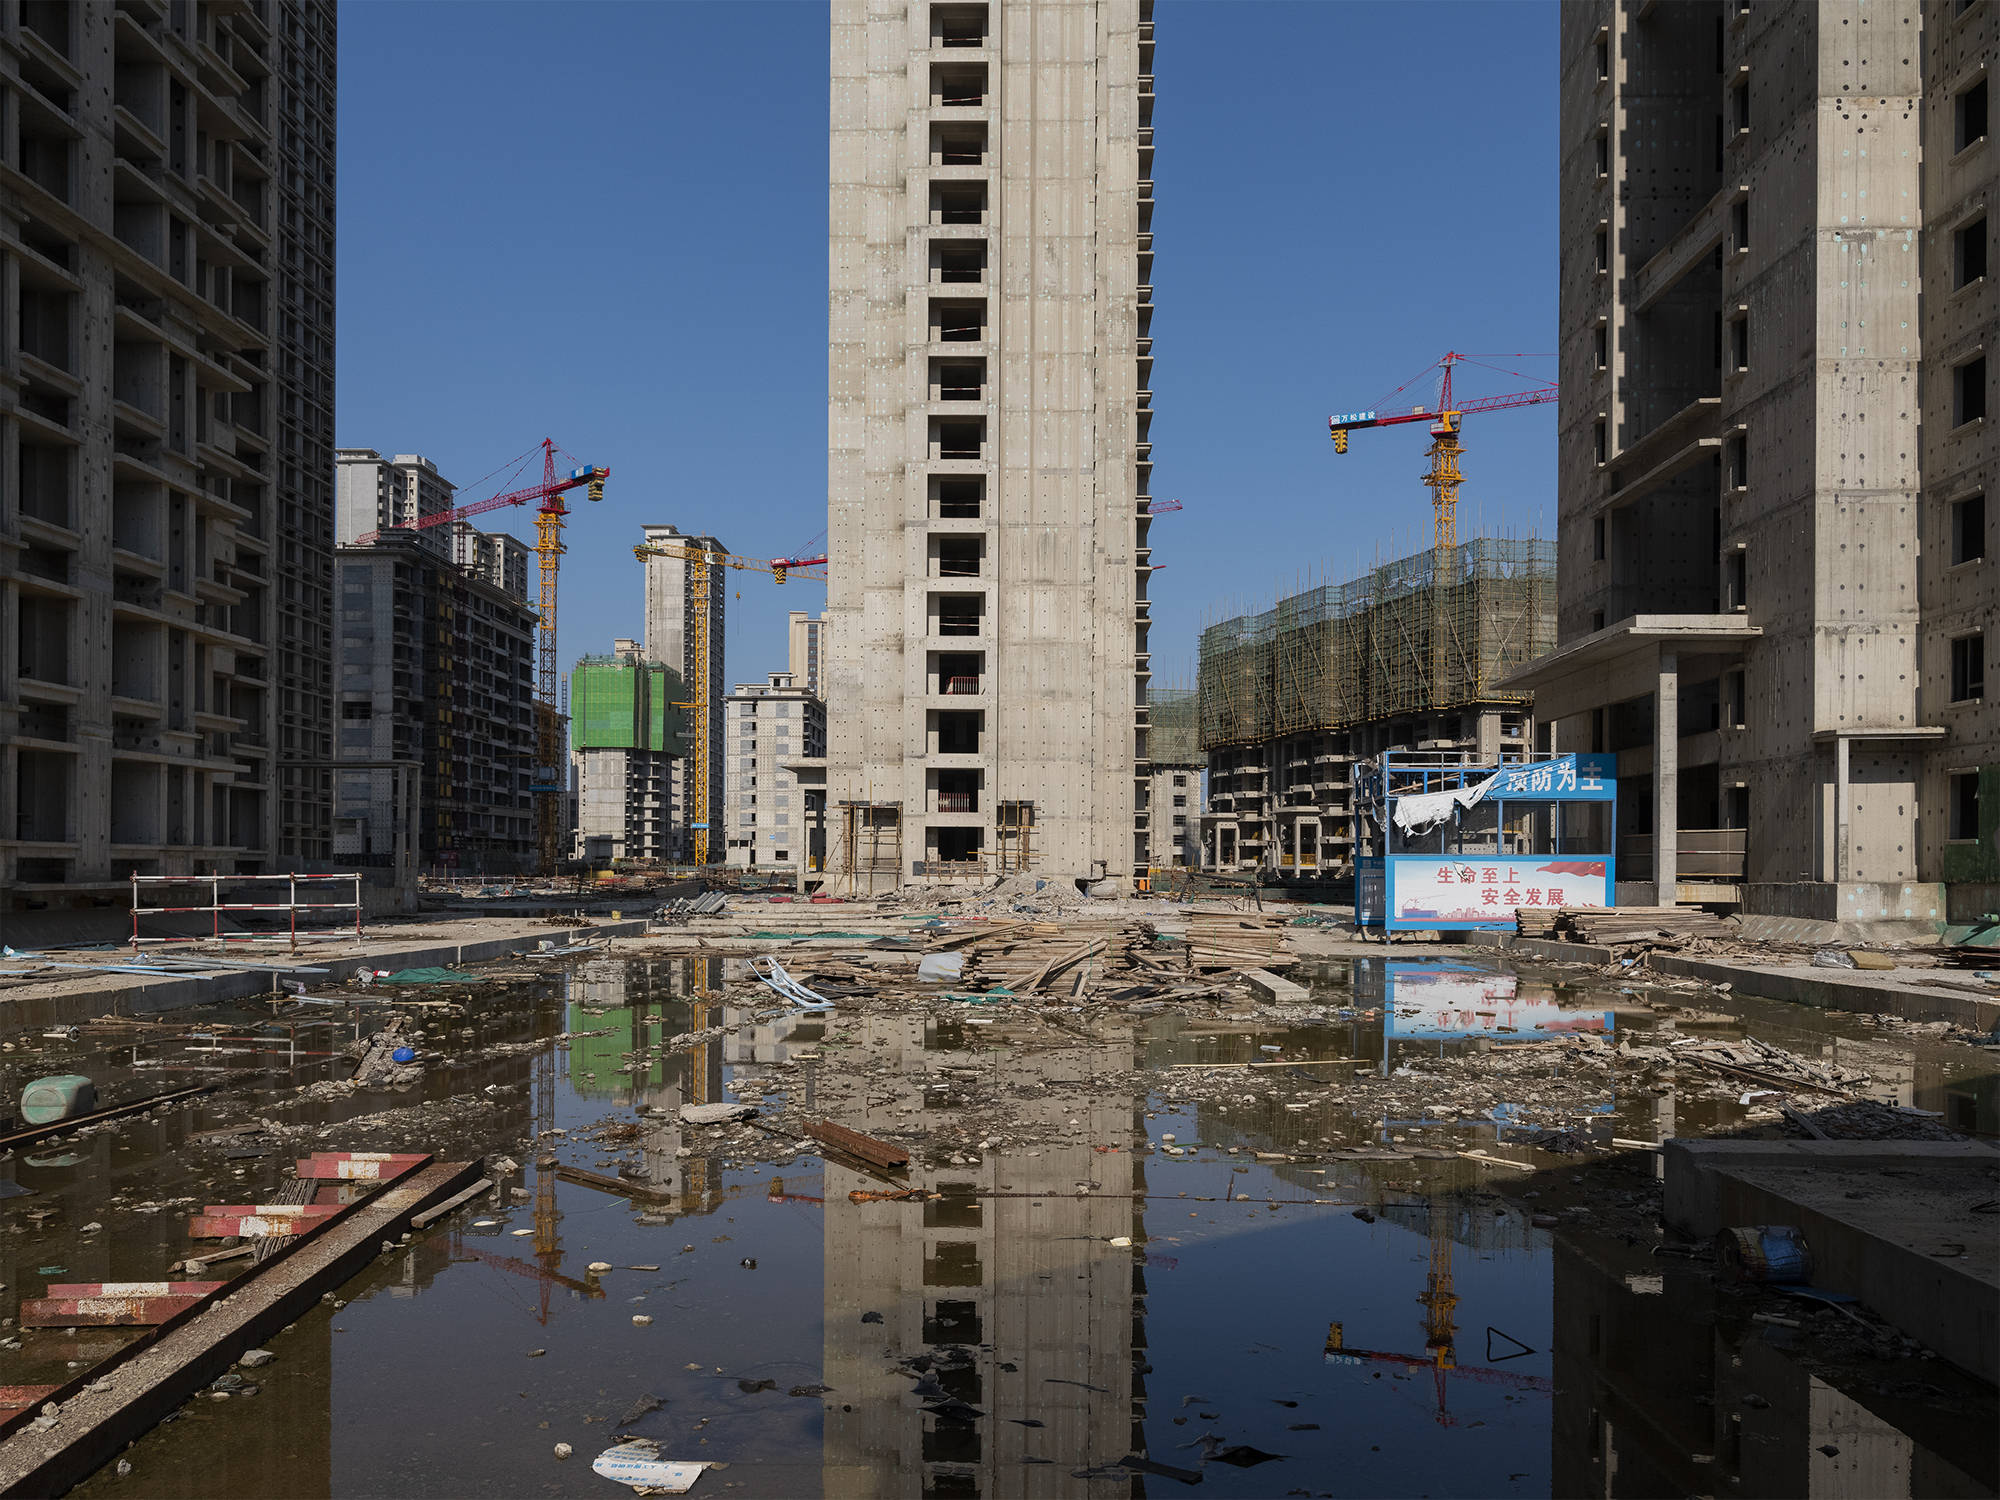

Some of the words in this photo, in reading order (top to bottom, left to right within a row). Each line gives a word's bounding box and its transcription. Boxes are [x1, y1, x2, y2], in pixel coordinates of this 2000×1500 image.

[1437, 866, 1521, 884] 生命至上
[1481, 888, 1564, 906] 安全发展
